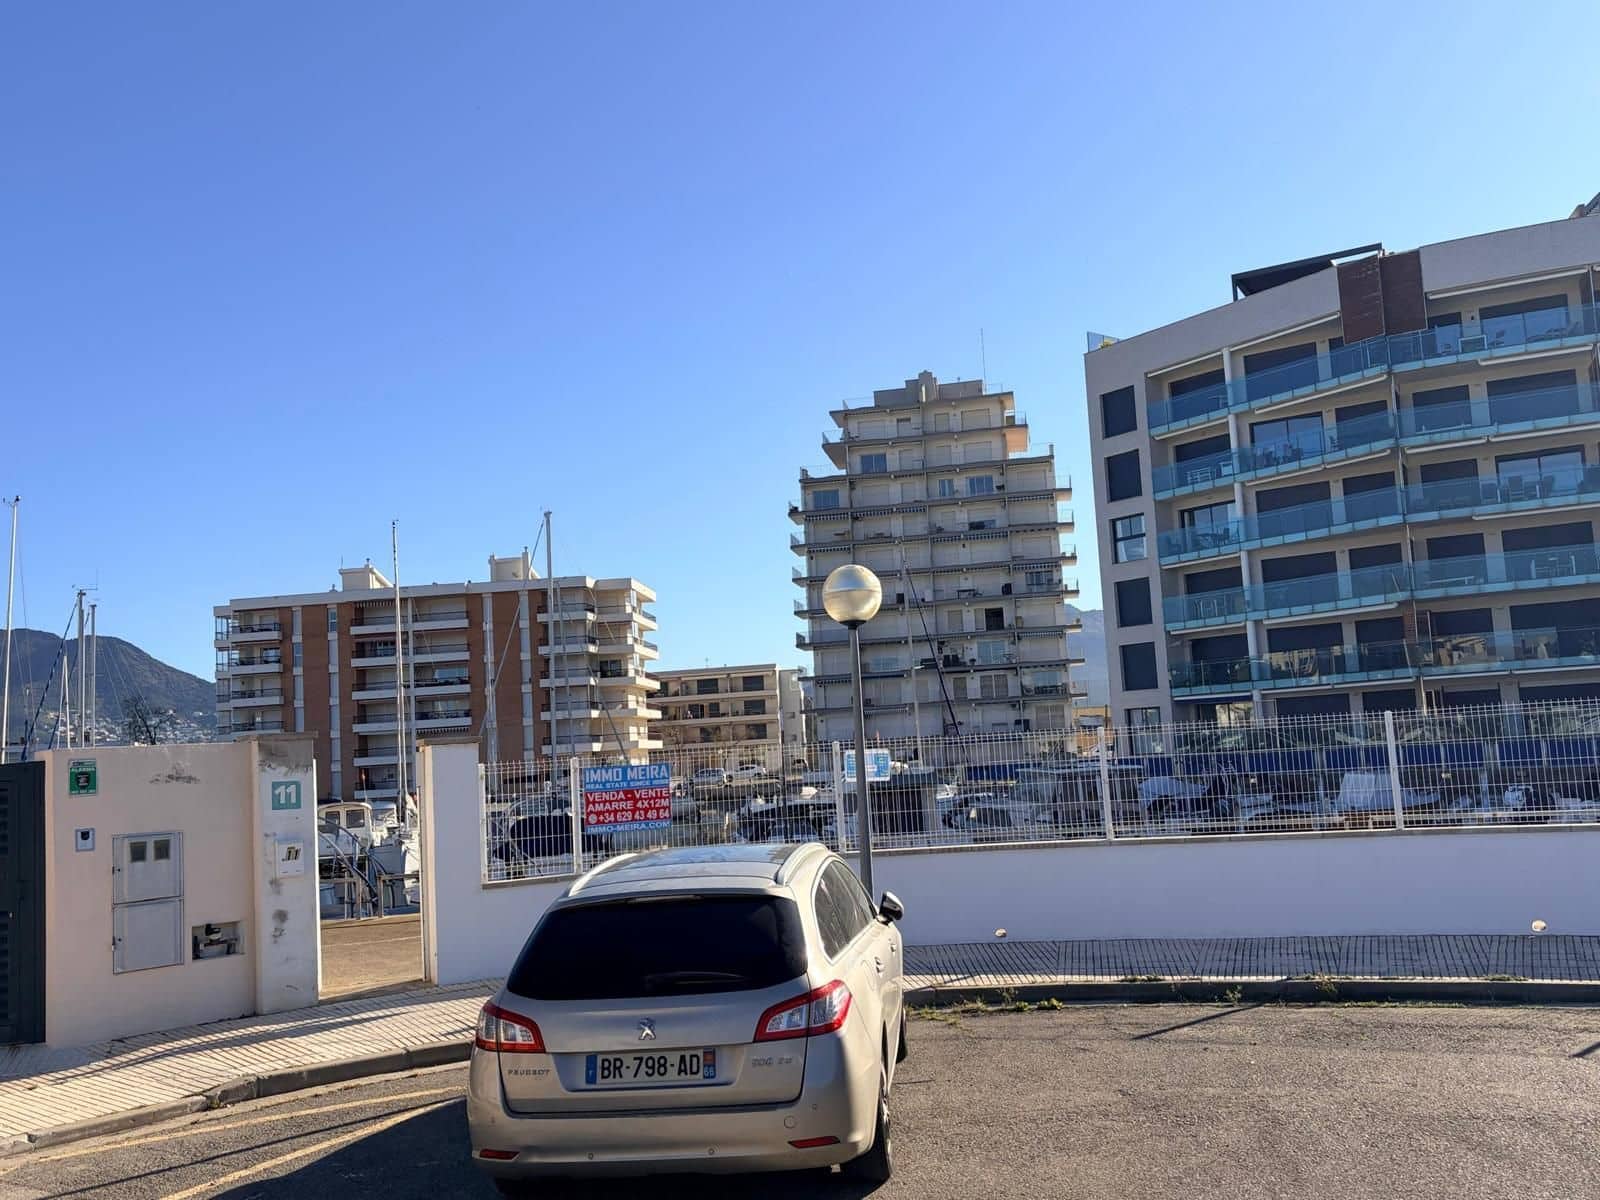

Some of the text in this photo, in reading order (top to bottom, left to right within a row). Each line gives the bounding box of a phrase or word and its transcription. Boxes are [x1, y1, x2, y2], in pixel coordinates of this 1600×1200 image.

[585, 765, 669, 783] IMMO MEIRA
[274, 784, 297, 804] 11
[587, 791, 625, 802] VENDA
[633, 789, 669, 799] VENTE
[587, 798, 669, 812] AMARRE 4X12M
[599, 812, 615, 823] +34
[634, 810, 645, 820] 43
[587, 821, 670, 833] IMMO-MEIRA.COM
[600, 1054, 700, 1079] BR-798-AD
